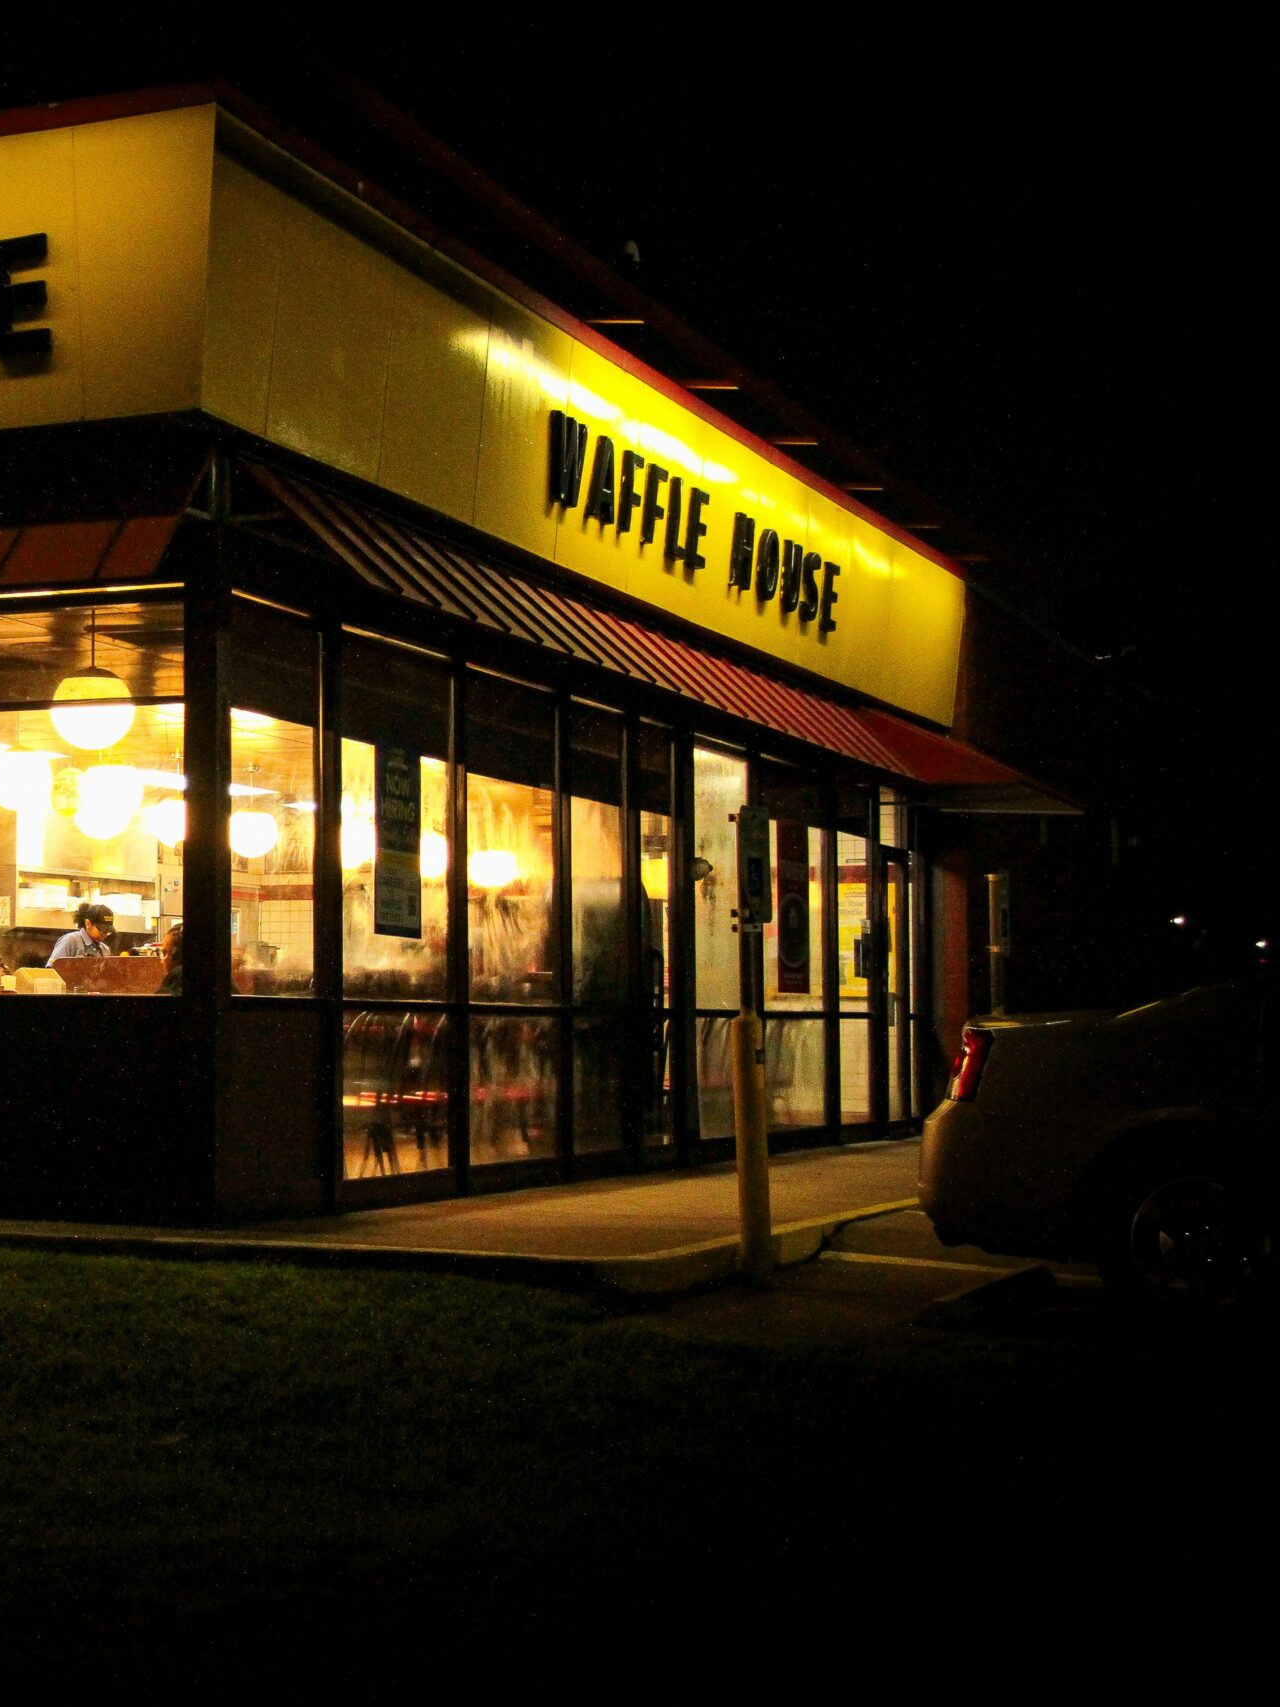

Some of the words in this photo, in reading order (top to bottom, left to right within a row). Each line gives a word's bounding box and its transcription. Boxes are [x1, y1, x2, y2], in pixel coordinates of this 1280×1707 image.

[548, 409, 710, 570] WAFFLE
[728, 511, 841, 634] HOUSE
[385, 772, 411, 798] NOW
